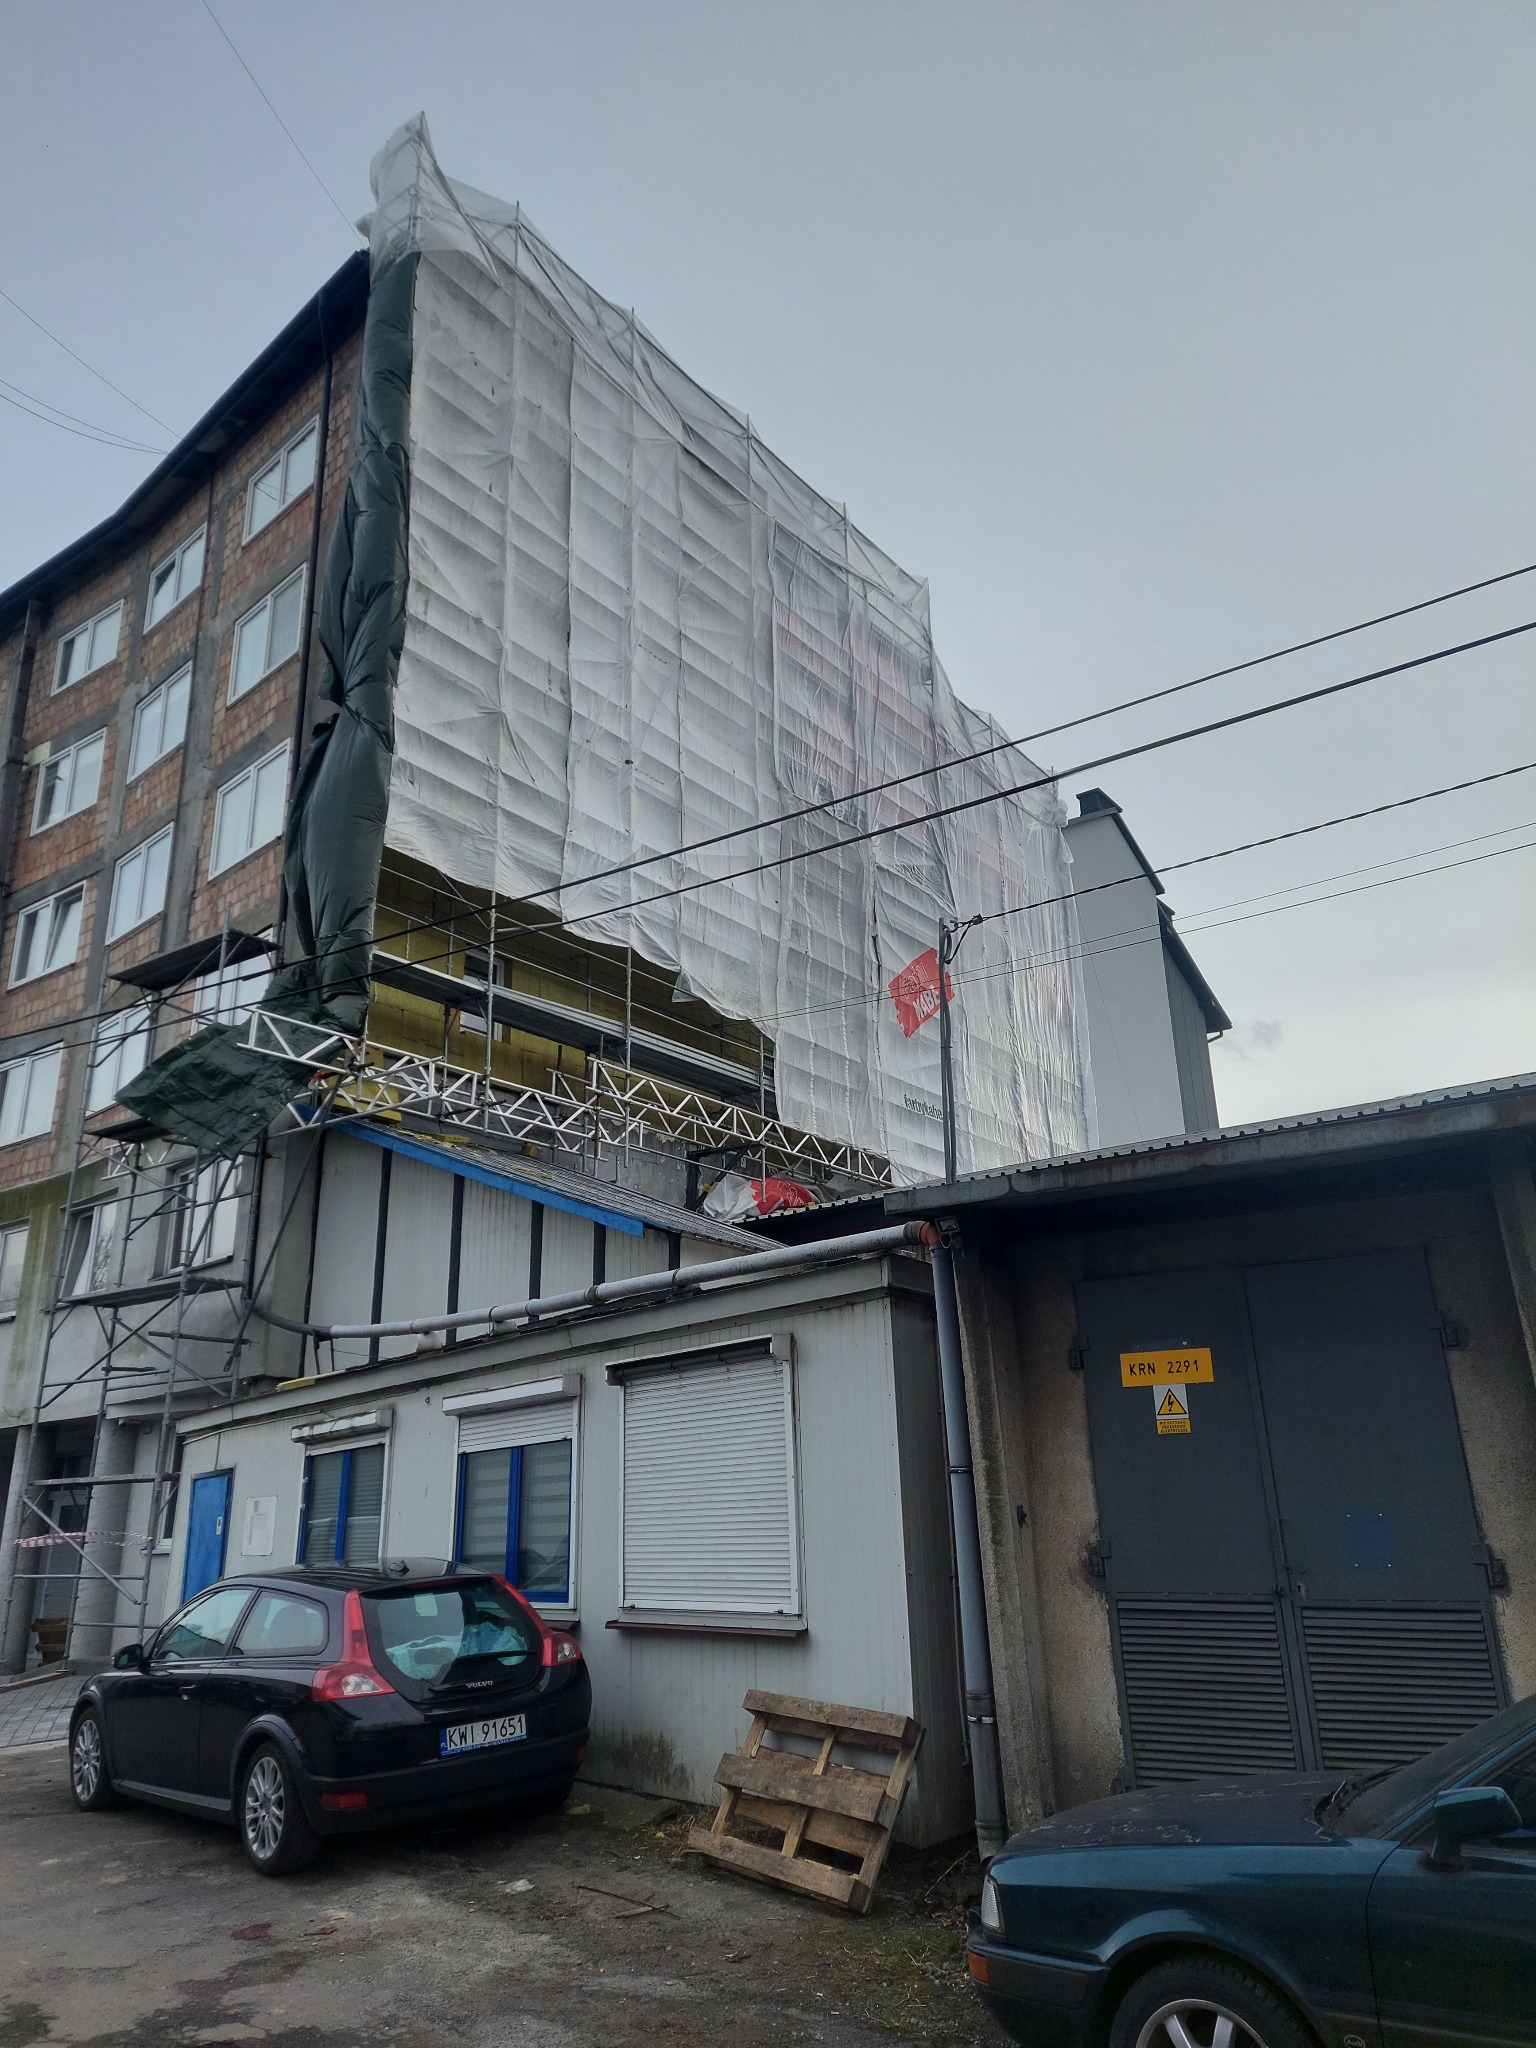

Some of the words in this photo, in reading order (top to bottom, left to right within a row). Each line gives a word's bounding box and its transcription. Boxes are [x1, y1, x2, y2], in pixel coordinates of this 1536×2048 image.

[1129, 1362, 1156, 1377] KRN
[1166, 1359, 1199, 1374] 2291
[465, 1680, 493, 1689] VOLVO
[448, 1725, 474, 1748] KWI
[481, 1715, 523, 1742] 91651
